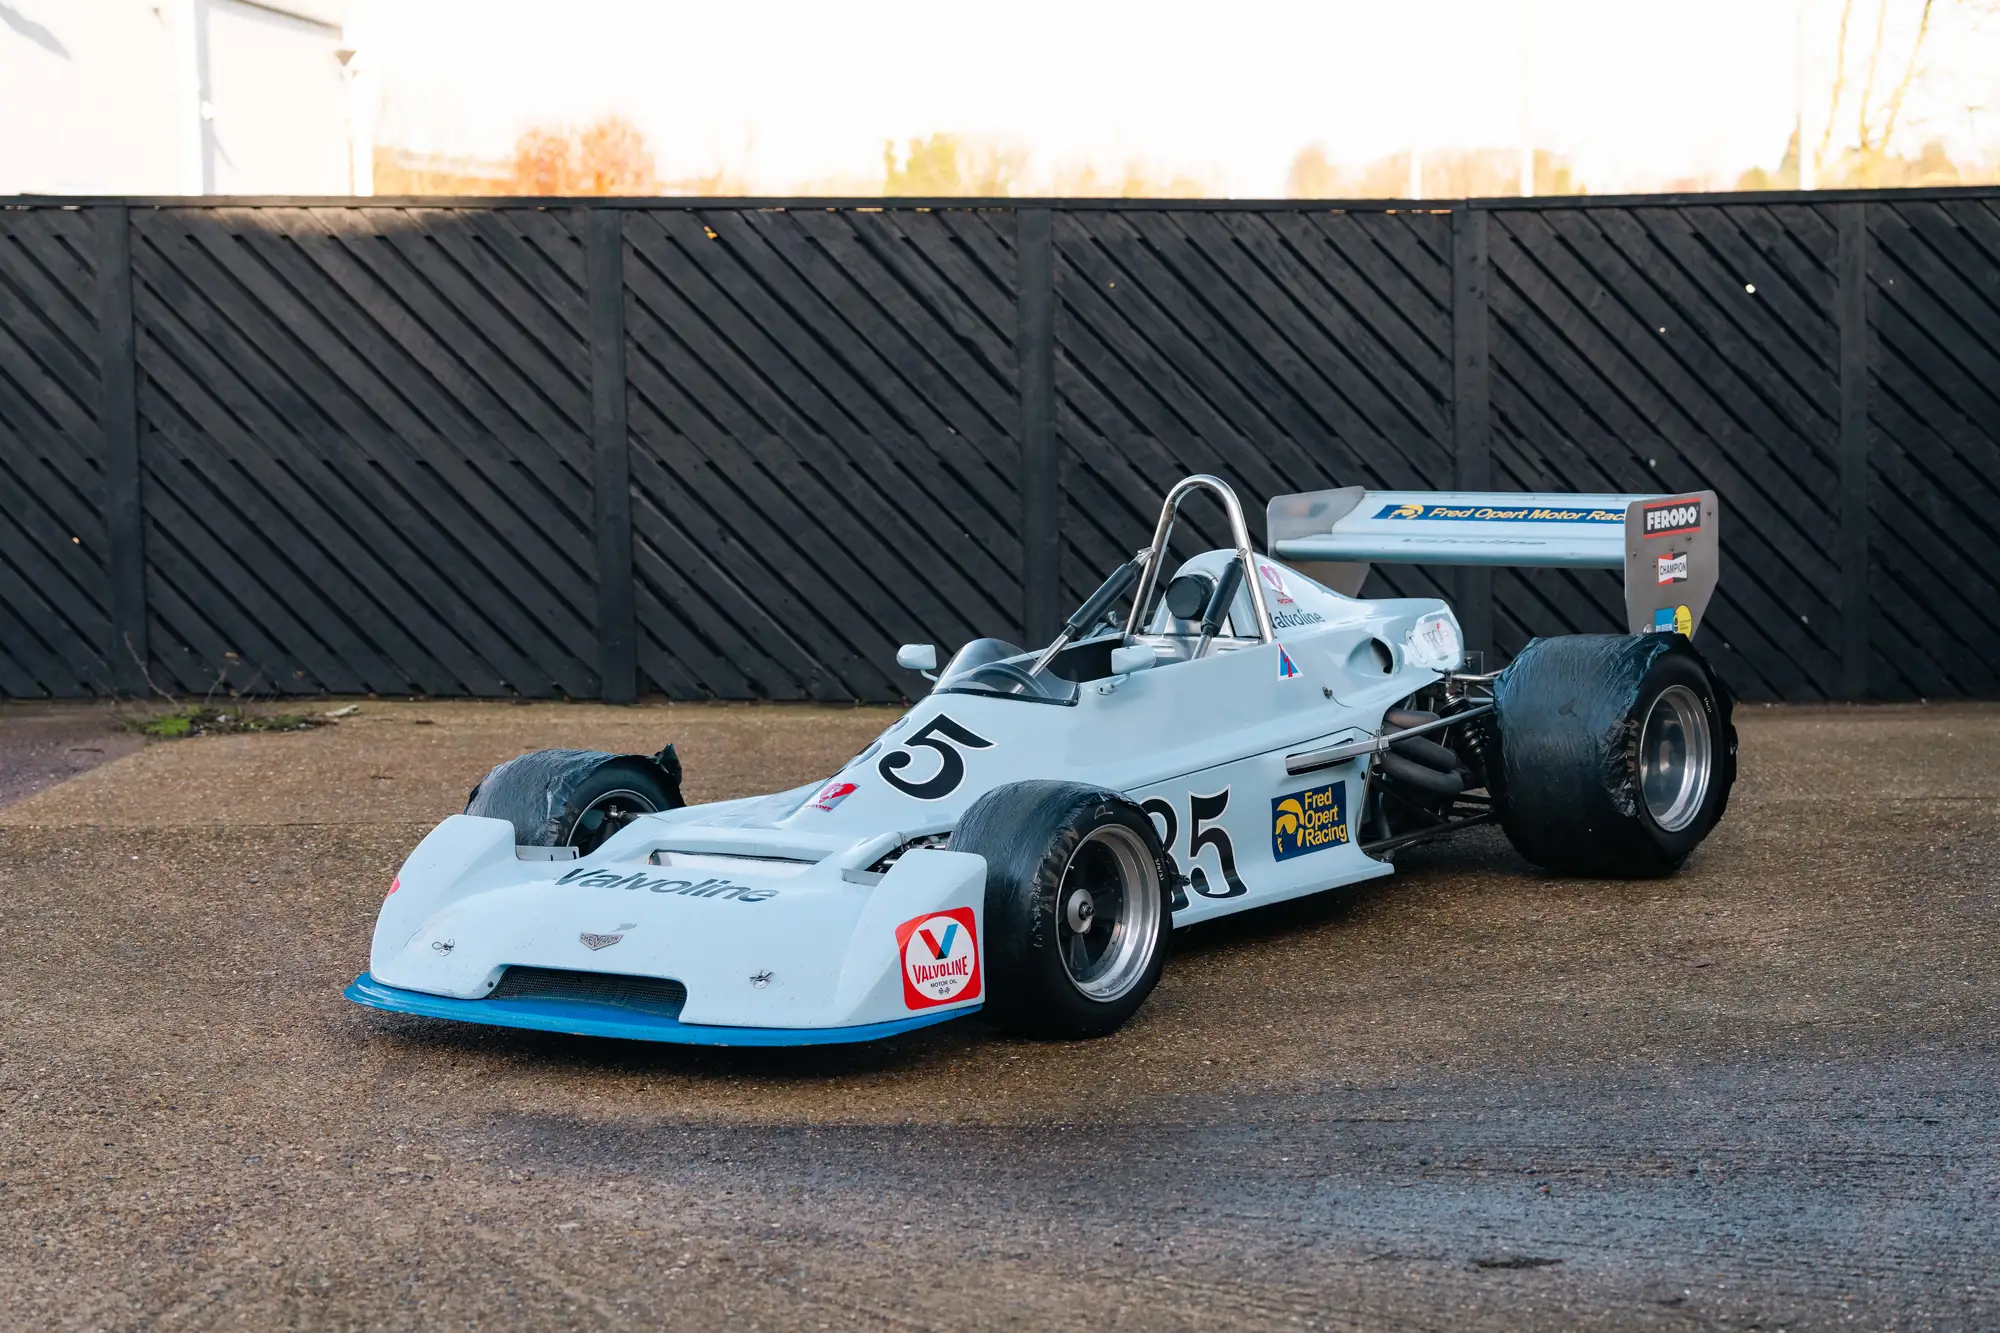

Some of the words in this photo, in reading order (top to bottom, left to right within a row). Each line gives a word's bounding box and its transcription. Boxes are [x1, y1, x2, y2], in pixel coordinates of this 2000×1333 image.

[1428, 507, 1474, 518] Fred
[1475, 508, 1528, 520] Opert
[1530, 509, 1587, 520] Motor
[1586, 510, 1625, 521] Rac
[1647, 506, 1697, 530] FERODO
[1660, 561, 1686, 576] CHAMPION
[878, 713, 996, 800] 5
[1304, 787, 1332, 810] Fred
[1304, 805, 1339, 828] Opert
[1305, 823, 1347, 847] Racing
[555, 868, 780, 902] Valvoline
[580, 931, 623, 950] CHEVRON
[912, 955, 969, 985] VALVOLINE
